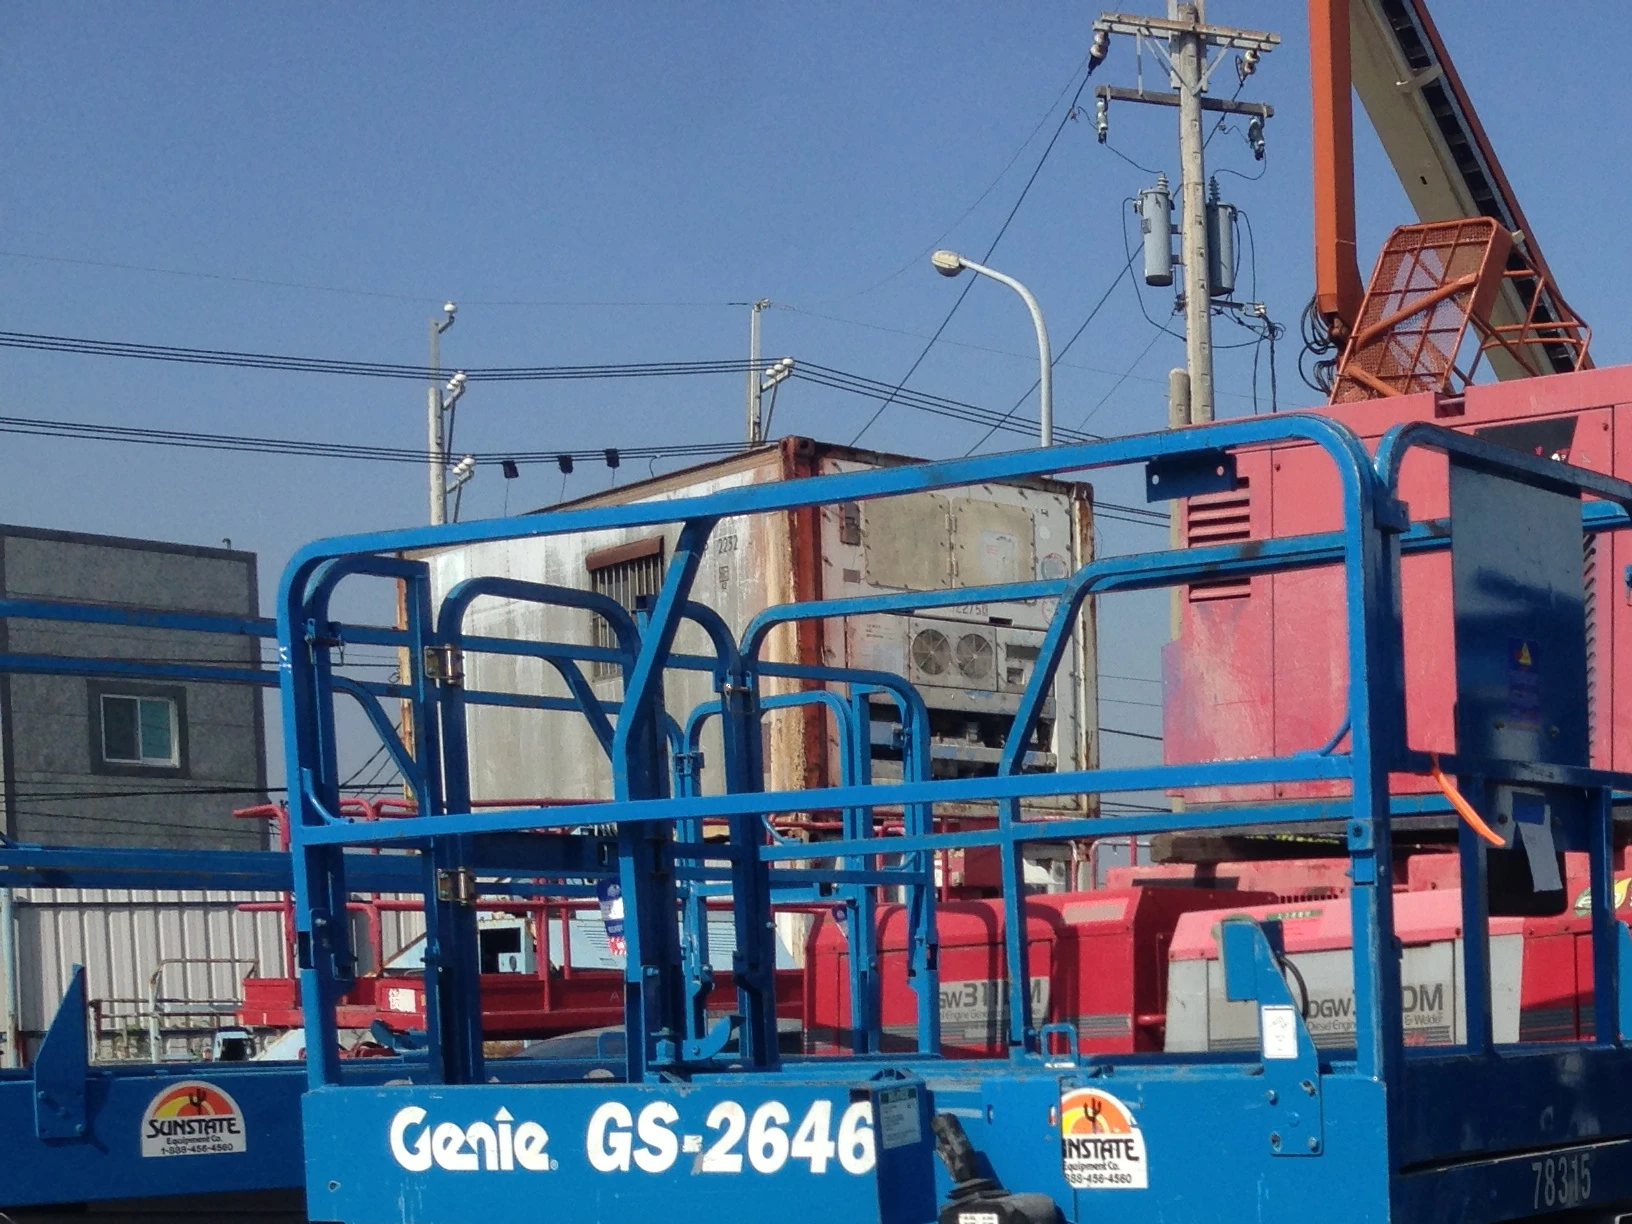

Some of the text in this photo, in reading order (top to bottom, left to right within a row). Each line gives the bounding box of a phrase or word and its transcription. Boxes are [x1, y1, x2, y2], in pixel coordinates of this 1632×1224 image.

[146, 1117, 241, 1139] SUNSTATE
[390, 1099, 877, 1176] Genie GS-2646
[1532, 1153, 1592, 1209] 78315
